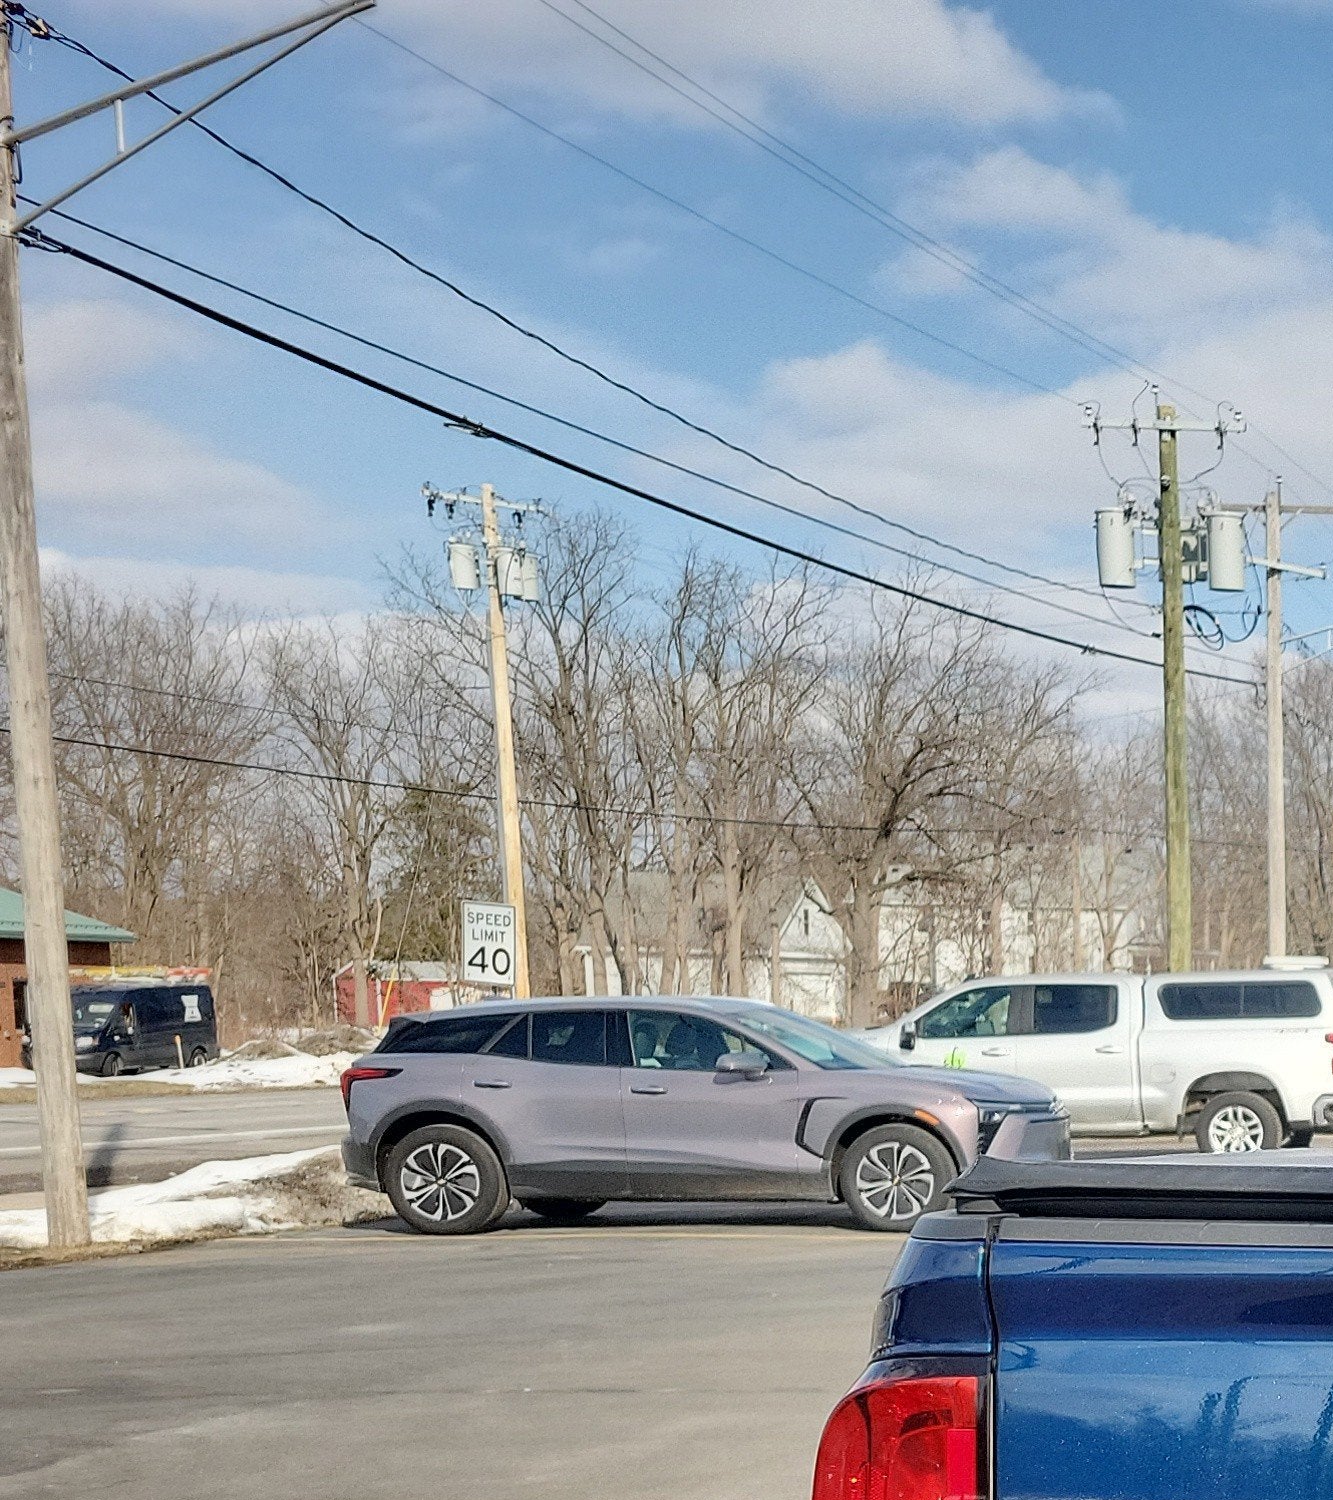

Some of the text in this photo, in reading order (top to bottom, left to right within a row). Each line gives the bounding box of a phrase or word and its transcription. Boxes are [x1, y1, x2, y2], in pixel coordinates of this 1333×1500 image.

[467, 911, 511, 927] SPEED
[471, 928, 506, 943] LIMIT
[468, 946, 511, 976] 40
